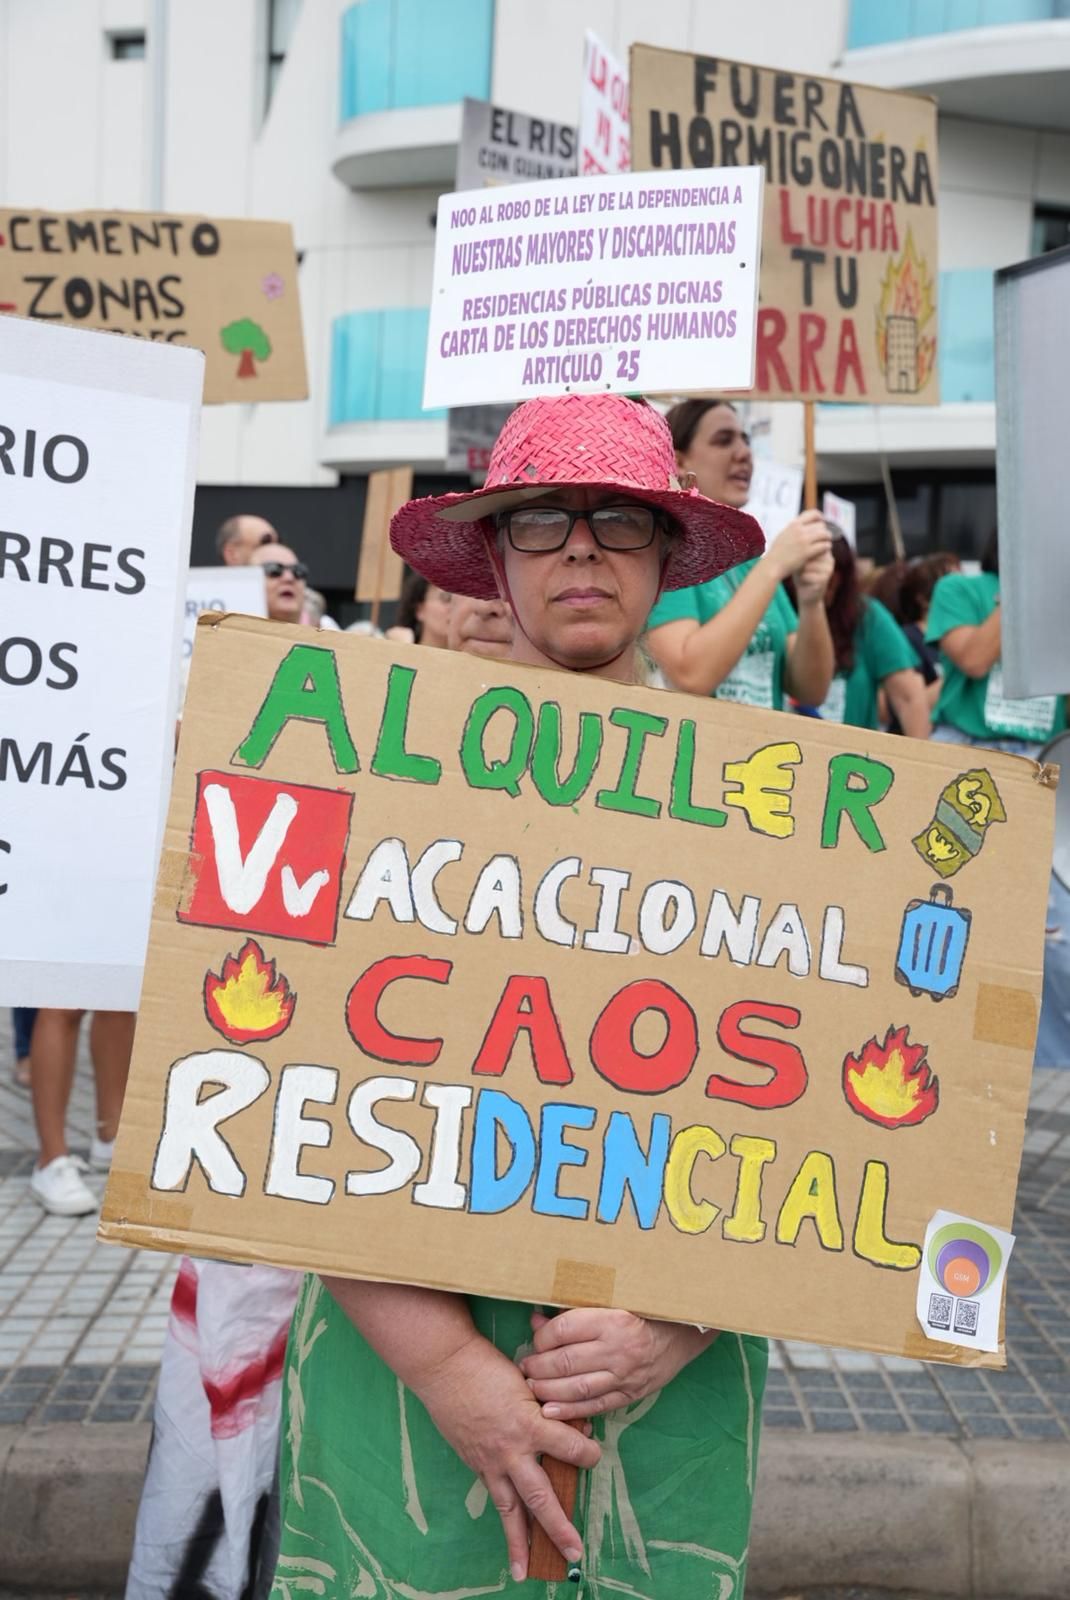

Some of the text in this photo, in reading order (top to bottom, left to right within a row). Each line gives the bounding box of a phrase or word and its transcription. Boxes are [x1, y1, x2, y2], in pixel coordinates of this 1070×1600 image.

[695, 56, 865, 138] FUERA
[491, 107, 519, 147] EL
[650, 110, 936, 206] HORMIGONERA
[451, 186, 742, 228] NOO AL ROBO DE LA LEY DE LA DEPENDENCIA A
[780, 189, 899, 252] LUCHA
[9, 216, 220, 256] CEMENTO
[451, 221, 736, 276] NUESTRAS MAYORES Y DISCAPACITADAS
[22, 276, 185, 321] ZONAS
[462, 279, 723, 321] RESIDENCIAS PÚBLICAS DIGNAS
[791, 248, 858, 309] TU
[440, 310, 737, 358] CARTA DE LOS DERECHOS HUMANOS
[522, 350, 640, 385] ARTICULO 25
[0, 530, 146, 595] RRES
[0, 636, 78, 690] OS
[0, 732, 127, 791] MÁS
[345, 954, 808, 1110] CAOS
[150, 1048, 922, 1271] RESIDENCIAL
